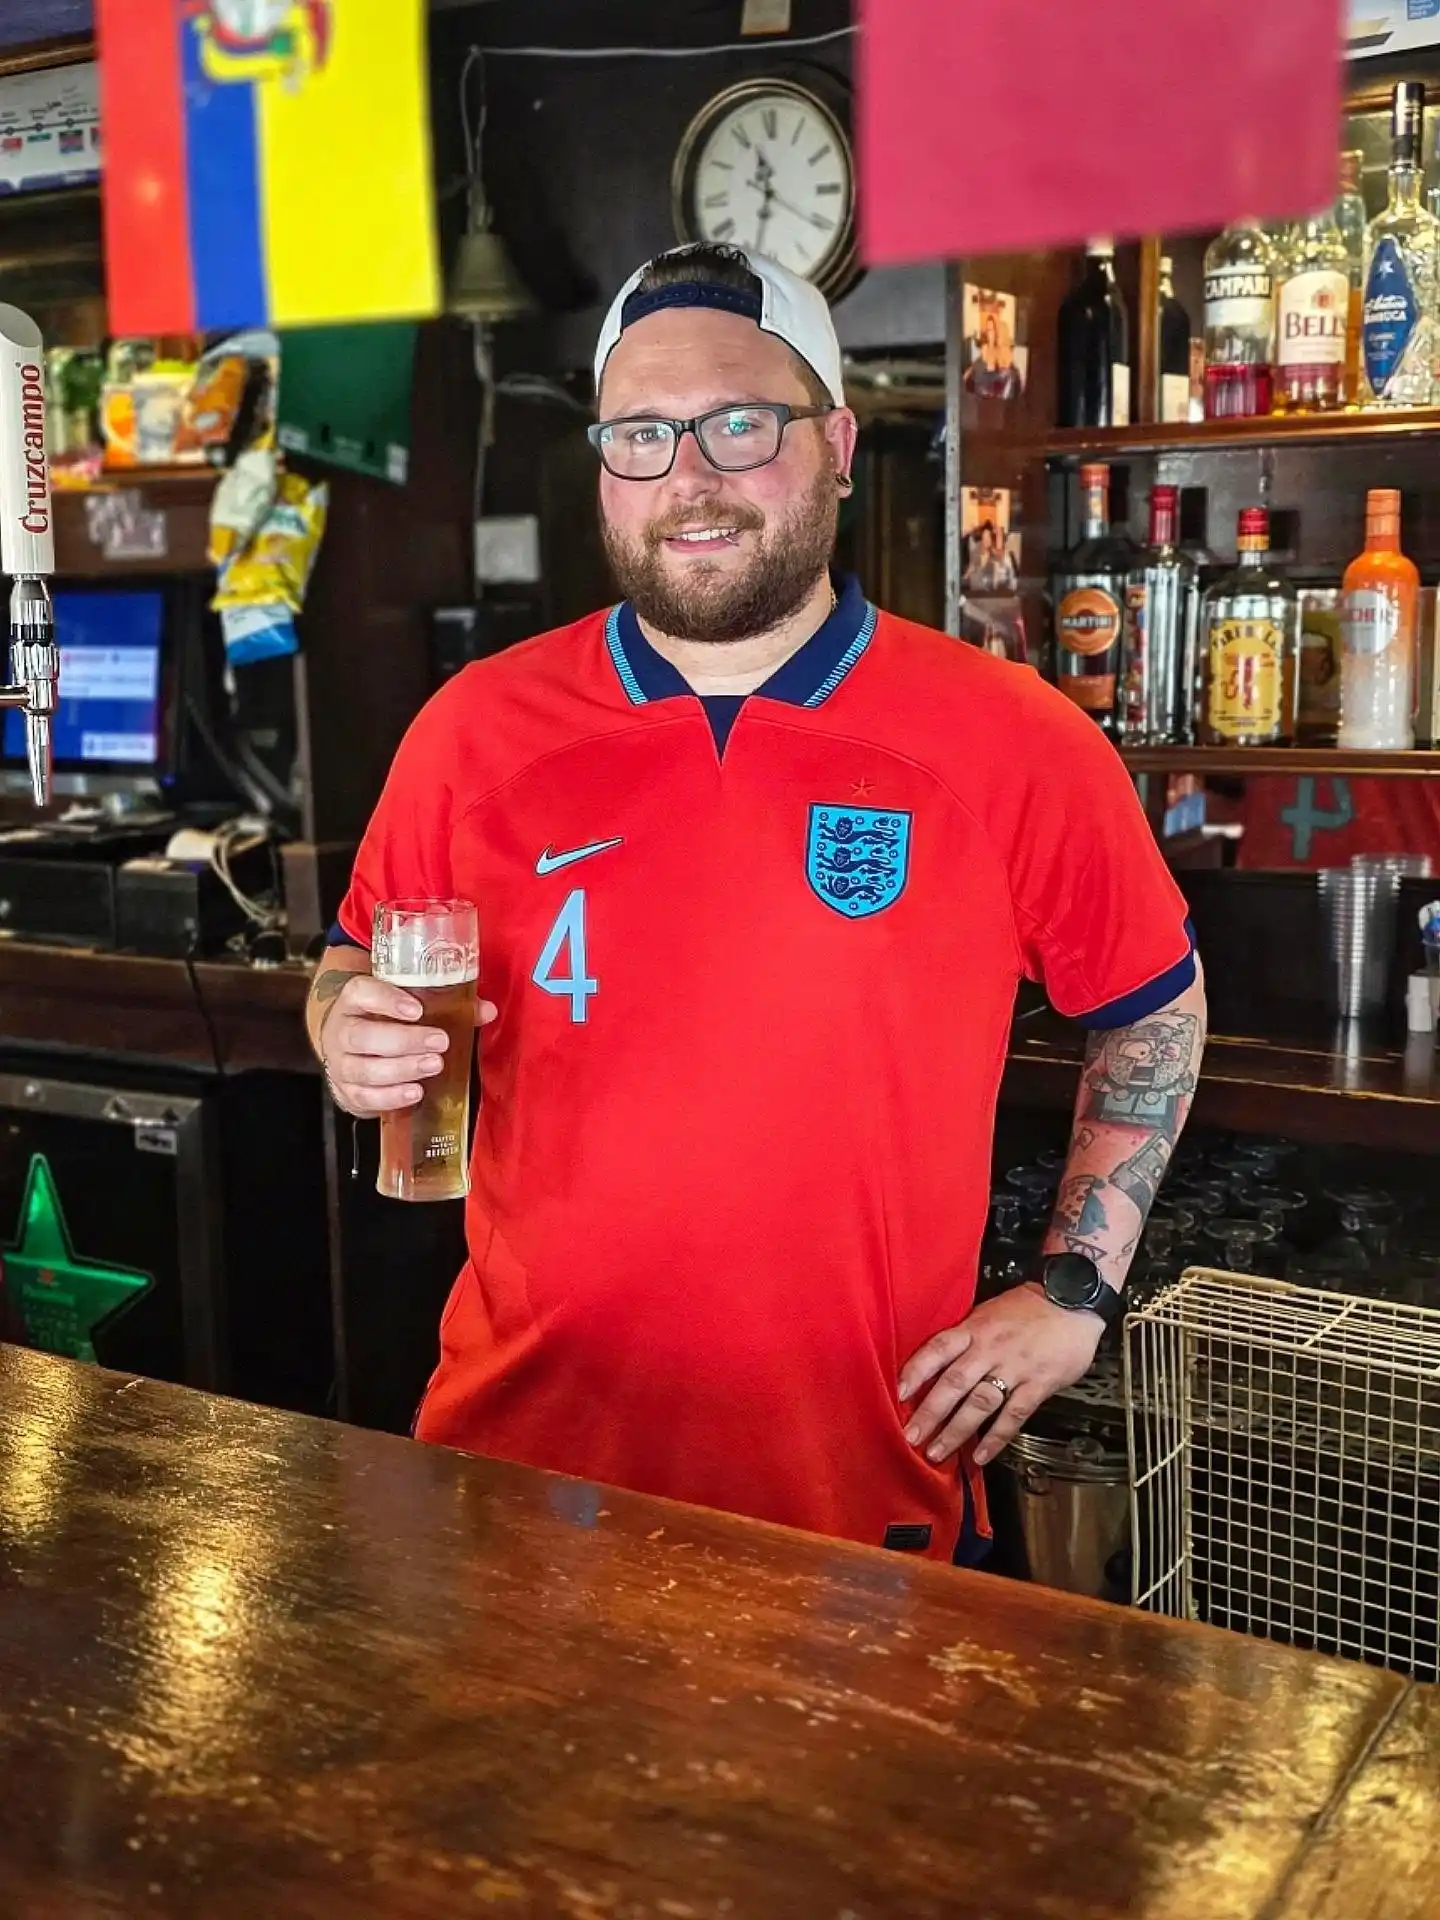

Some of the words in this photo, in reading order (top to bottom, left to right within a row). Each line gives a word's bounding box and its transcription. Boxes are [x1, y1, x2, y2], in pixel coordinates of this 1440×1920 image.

[1205, 275, 1270, 299] CAMPARI
[17, 363, 49, 535] Cruzcampo
[530, 886, 599, 1025] 4
